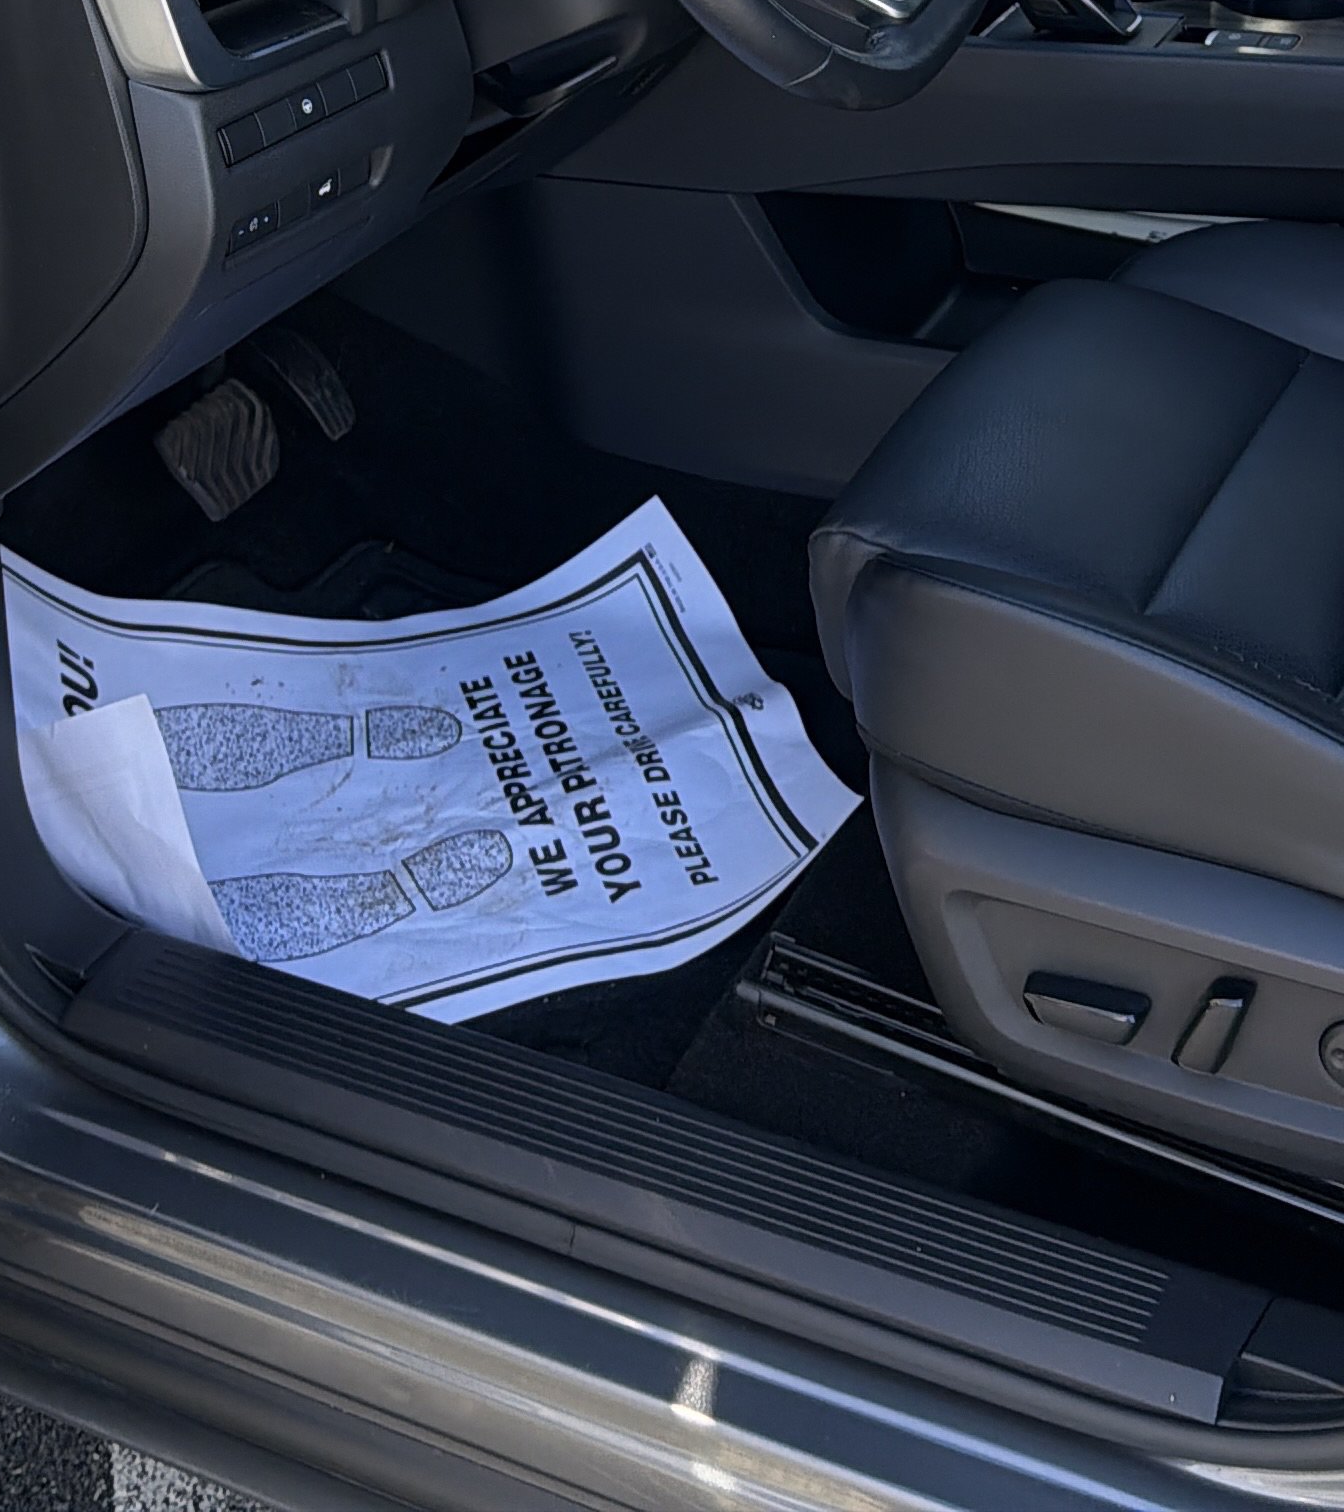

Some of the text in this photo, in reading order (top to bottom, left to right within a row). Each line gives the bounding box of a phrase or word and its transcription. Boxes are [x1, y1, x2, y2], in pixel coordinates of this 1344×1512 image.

[568, 629, 642, 738] CAREFULLY!
[459, 675, 579, 897] WE APPRECIATE
[503, 650, 643, 904] YOUR PATRONAGE
[651, 790, 720, 886] PLEASE
